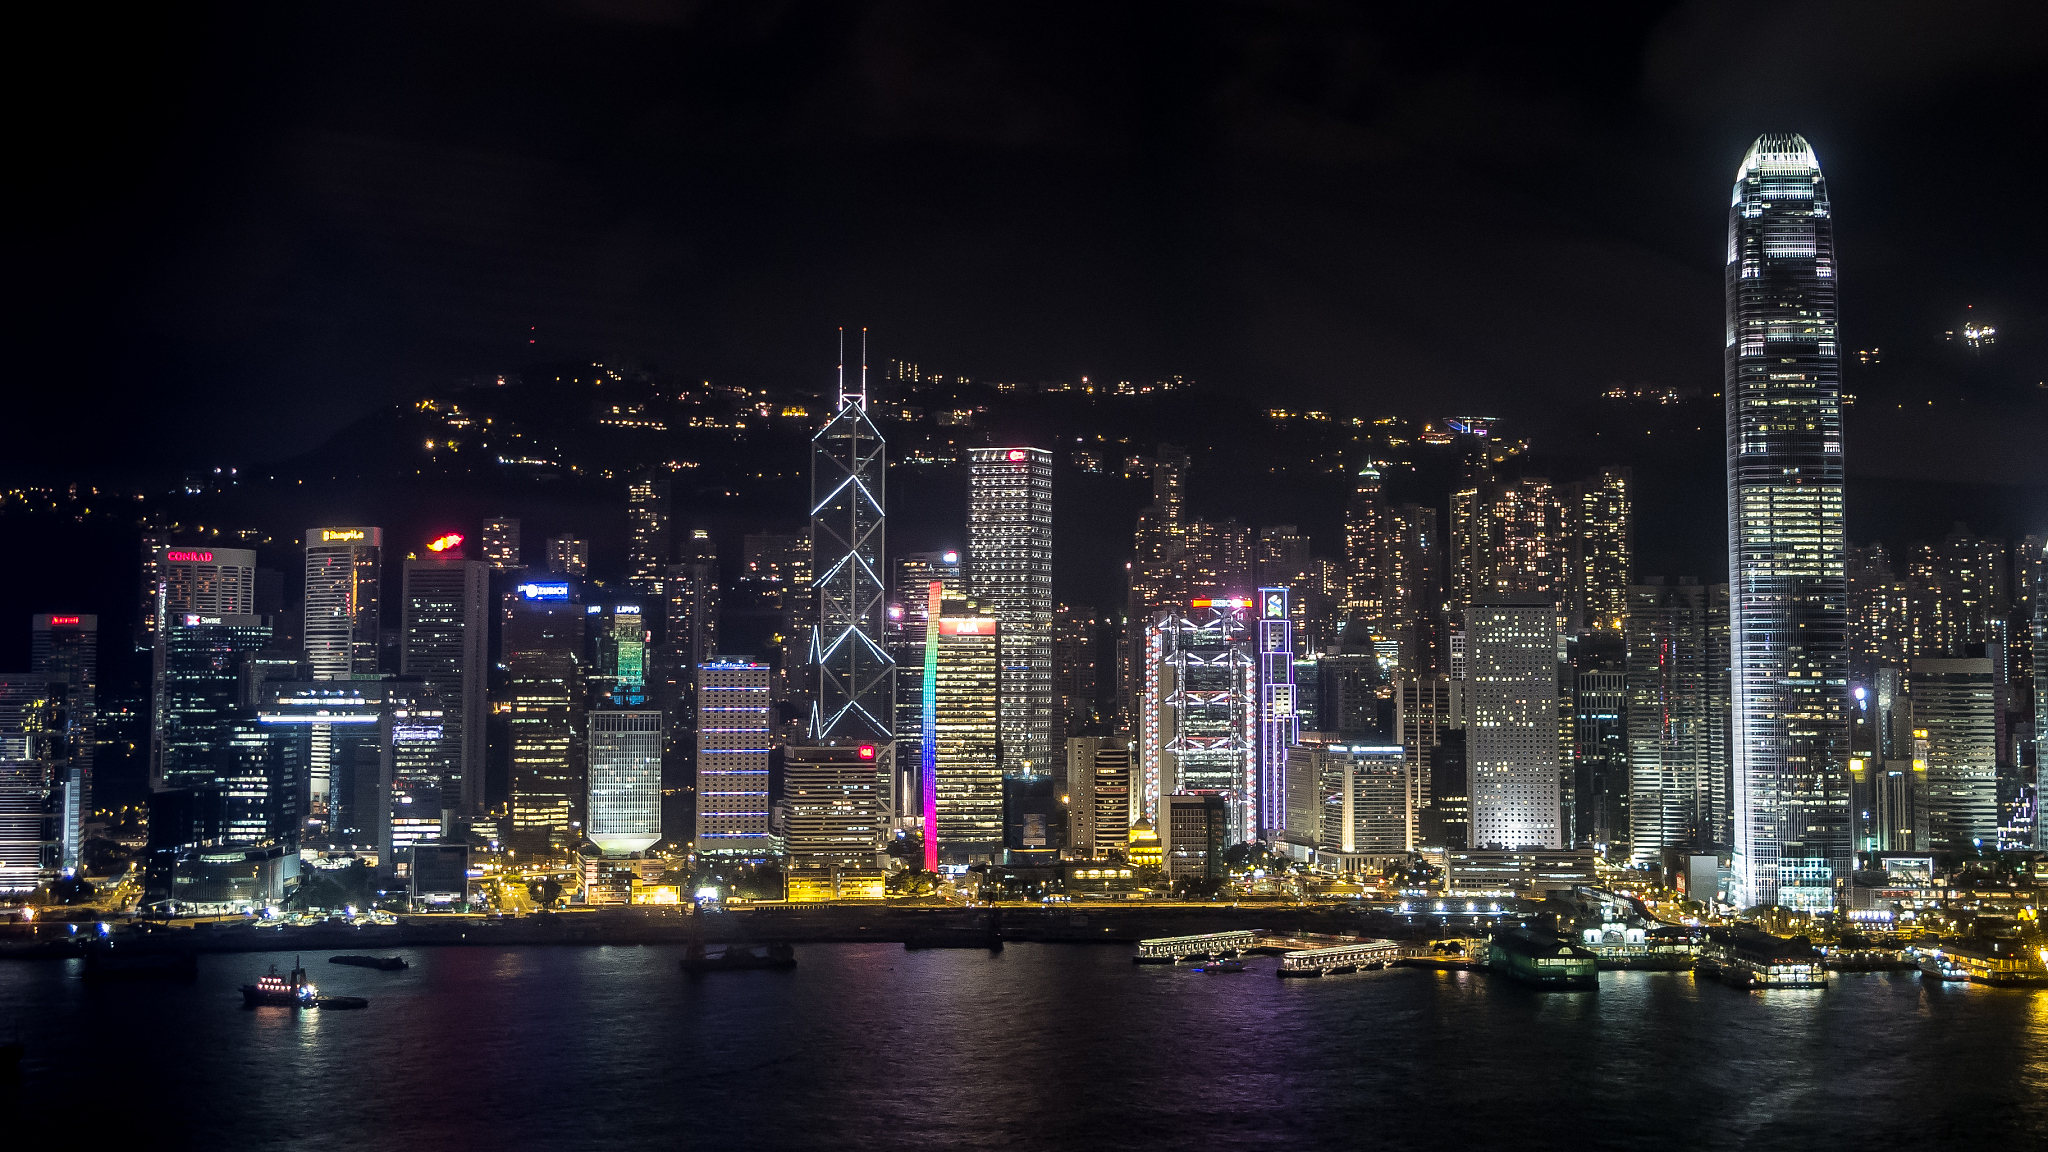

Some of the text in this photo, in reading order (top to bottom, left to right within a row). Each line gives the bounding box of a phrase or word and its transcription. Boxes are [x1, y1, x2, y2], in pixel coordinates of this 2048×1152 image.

[168, 551, 213, 562] CONRAD
[537, 586, 568, 595] ZURICH
[616, 605, 640, 613] LIPPO
[957, 622, 979, 633] AIA
